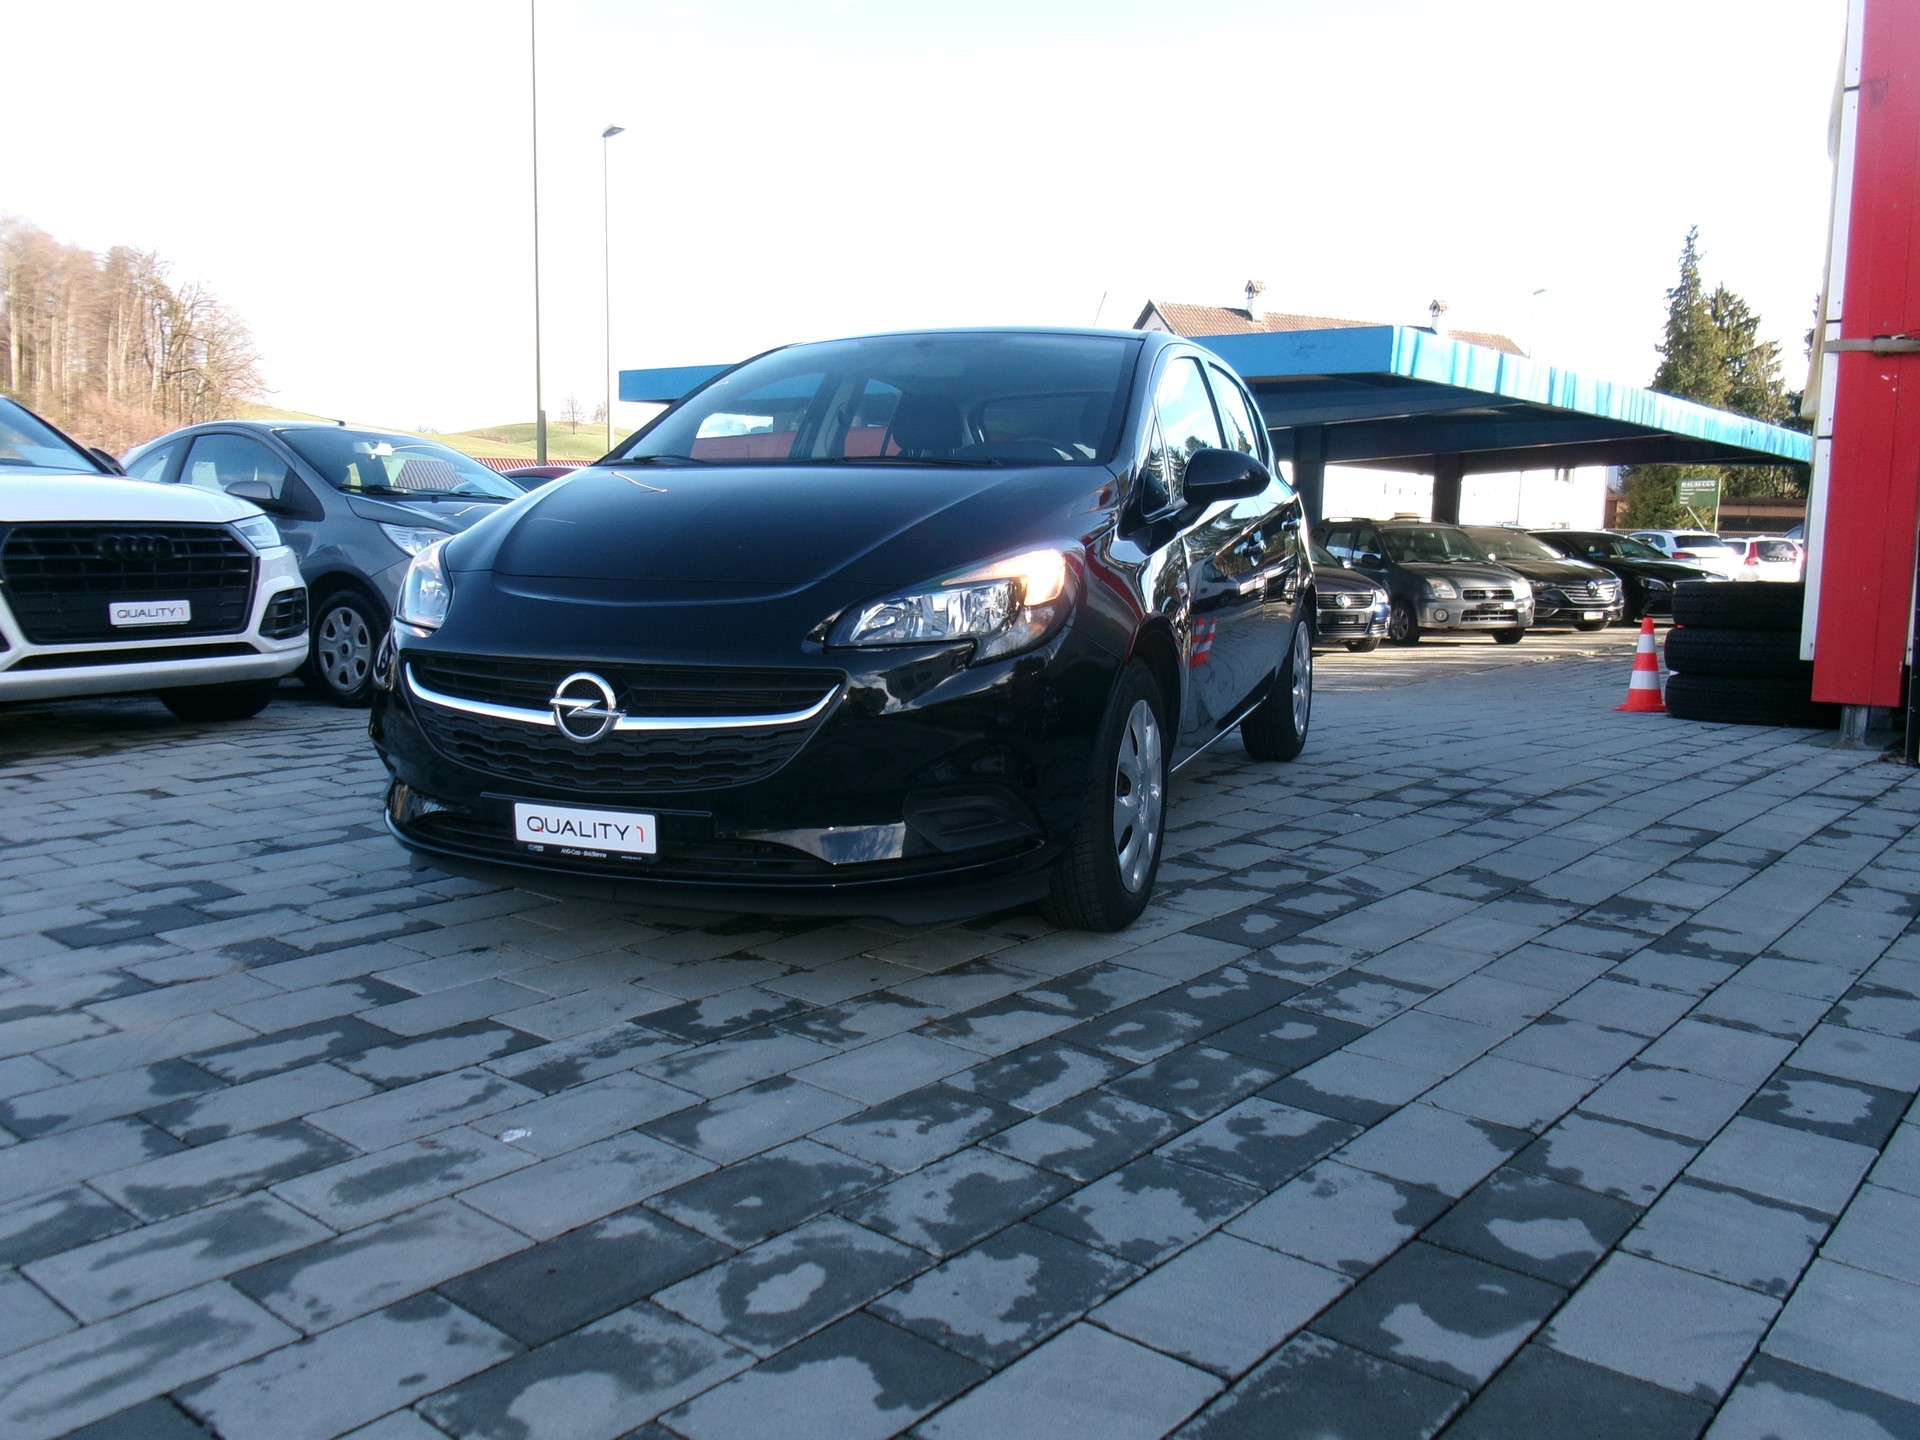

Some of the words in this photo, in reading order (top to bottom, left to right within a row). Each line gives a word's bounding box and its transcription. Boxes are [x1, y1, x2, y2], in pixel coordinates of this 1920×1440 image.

[117, 608, 176, 618] QUALITY
[527, 816, 630, 841] QUALITY
[636, 826, 644, 843] 1
